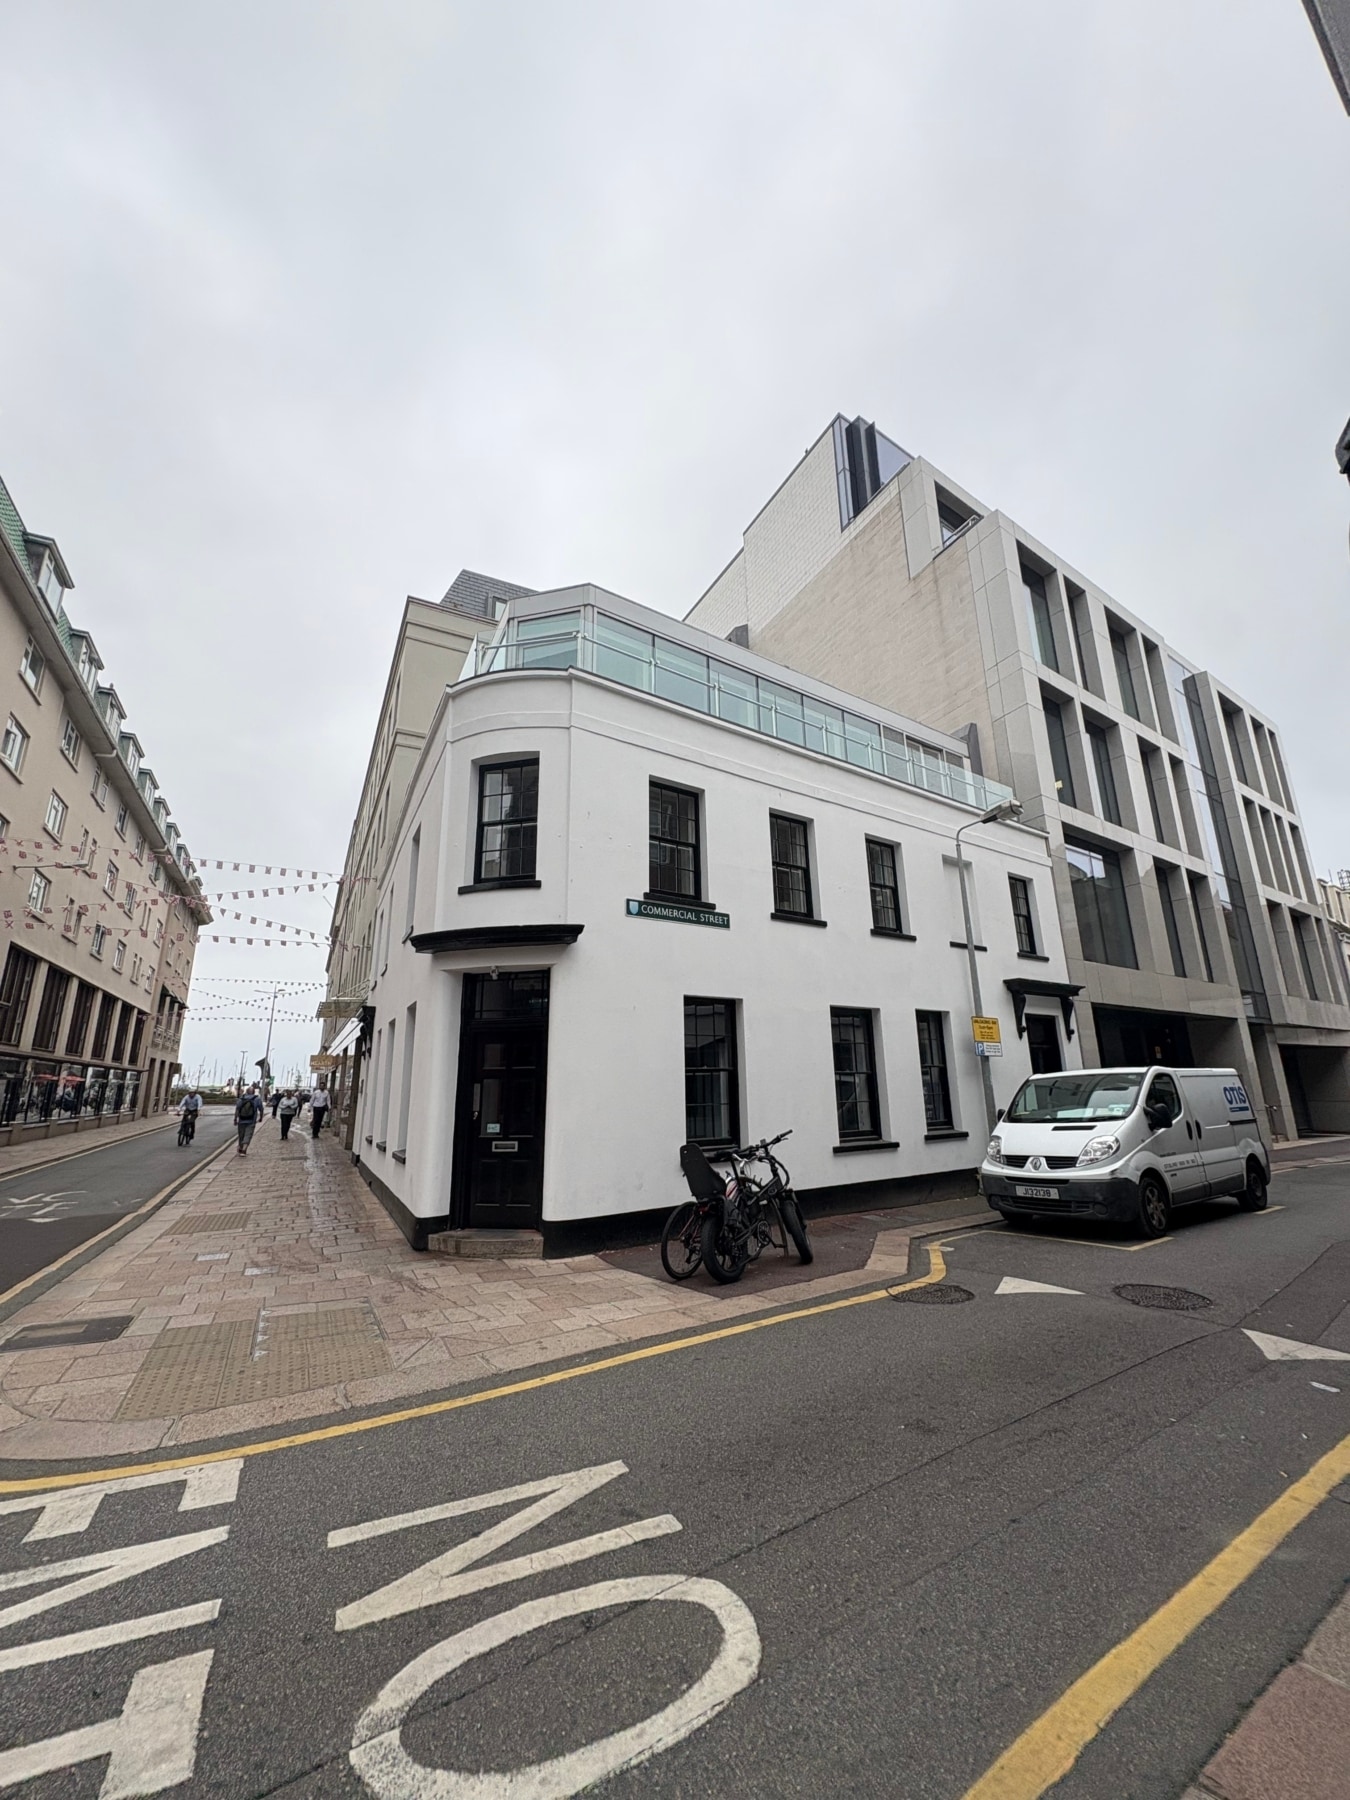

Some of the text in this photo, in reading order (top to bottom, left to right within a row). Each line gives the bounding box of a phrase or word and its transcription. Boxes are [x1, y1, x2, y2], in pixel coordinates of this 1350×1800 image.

[641, 904, 729, 925] COMMERCIAL STREET
[1223, 1082, 1247, 1105] OTIS
[326, 1458, 763, 1800] NO
